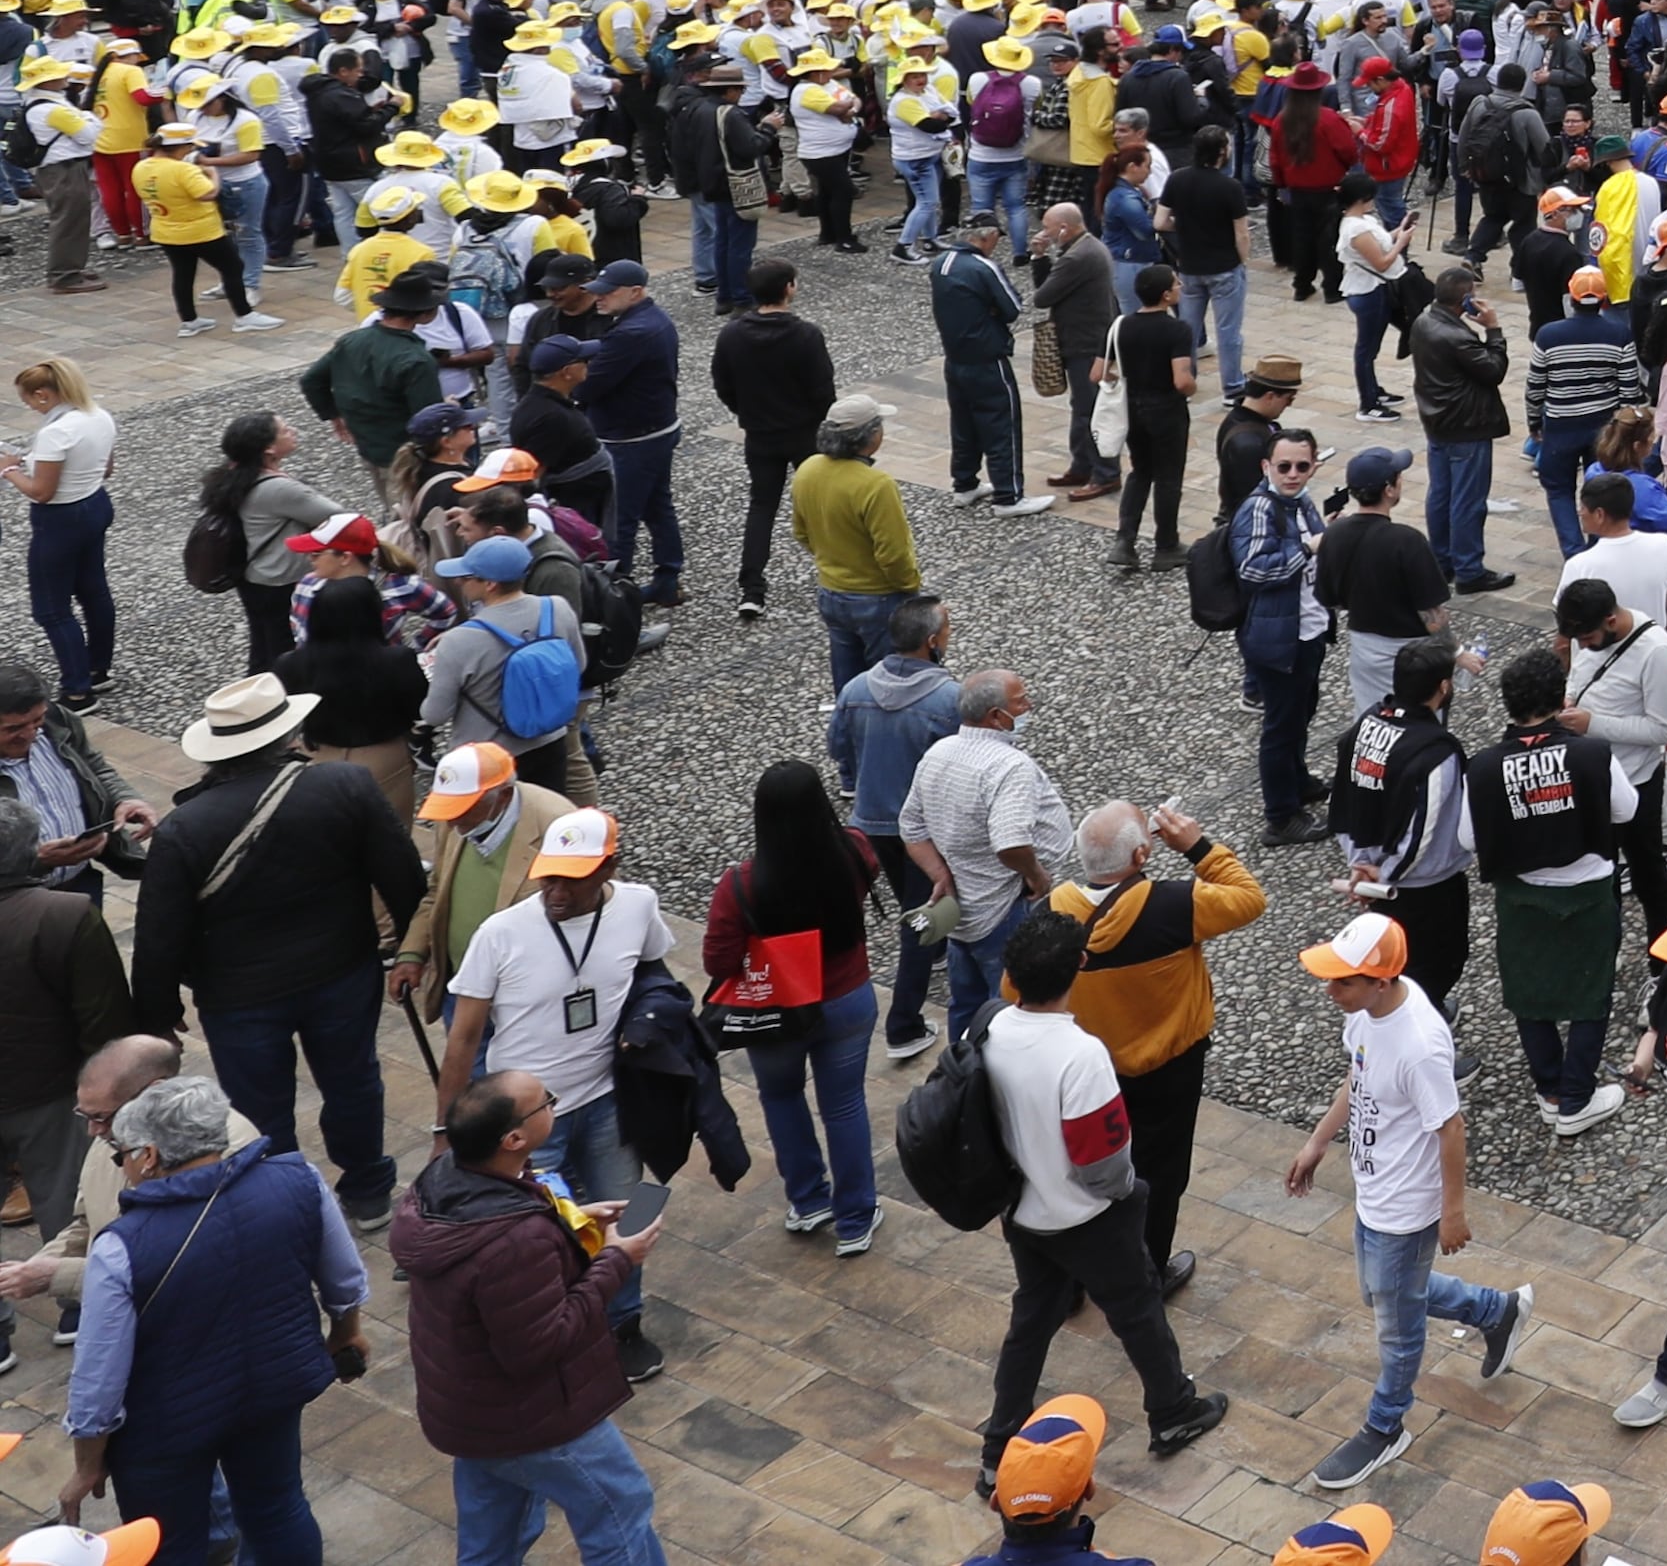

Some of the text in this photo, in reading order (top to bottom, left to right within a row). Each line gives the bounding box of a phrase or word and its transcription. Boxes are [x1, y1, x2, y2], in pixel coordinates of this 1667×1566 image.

[1502, 748, 1567, 784] READY
[1523, 778, 1537, 791] LA
[1539, 771, 1571, 787] CALLE
[1508, 784, 1573, 808] EL CAMBIO
[1511, 796, 1575, 820] NO TIEMBLA
[1104, 1109, 1125, 1146] 5
